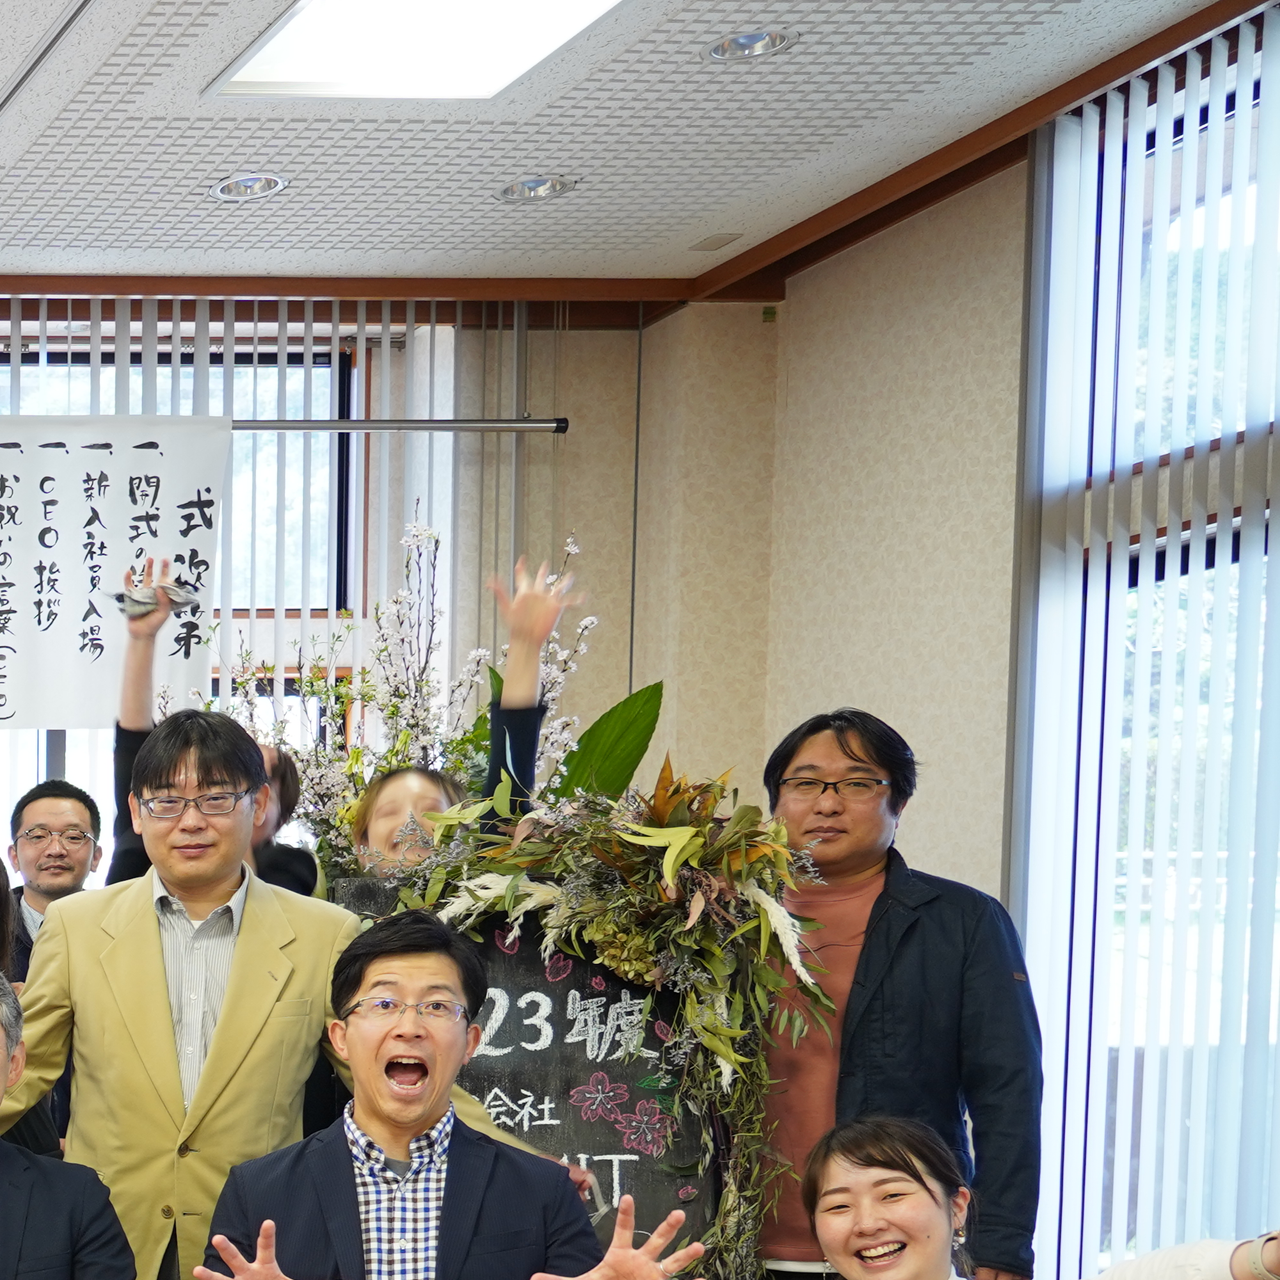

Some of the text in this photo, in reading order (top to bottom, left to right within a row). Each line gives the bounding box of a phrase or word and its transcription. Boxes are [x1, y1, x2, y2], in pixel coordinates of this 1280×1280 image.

[78, 442, 113, 664] 一、新入社員入場
[472, 1087, 561, 1132] 会社
